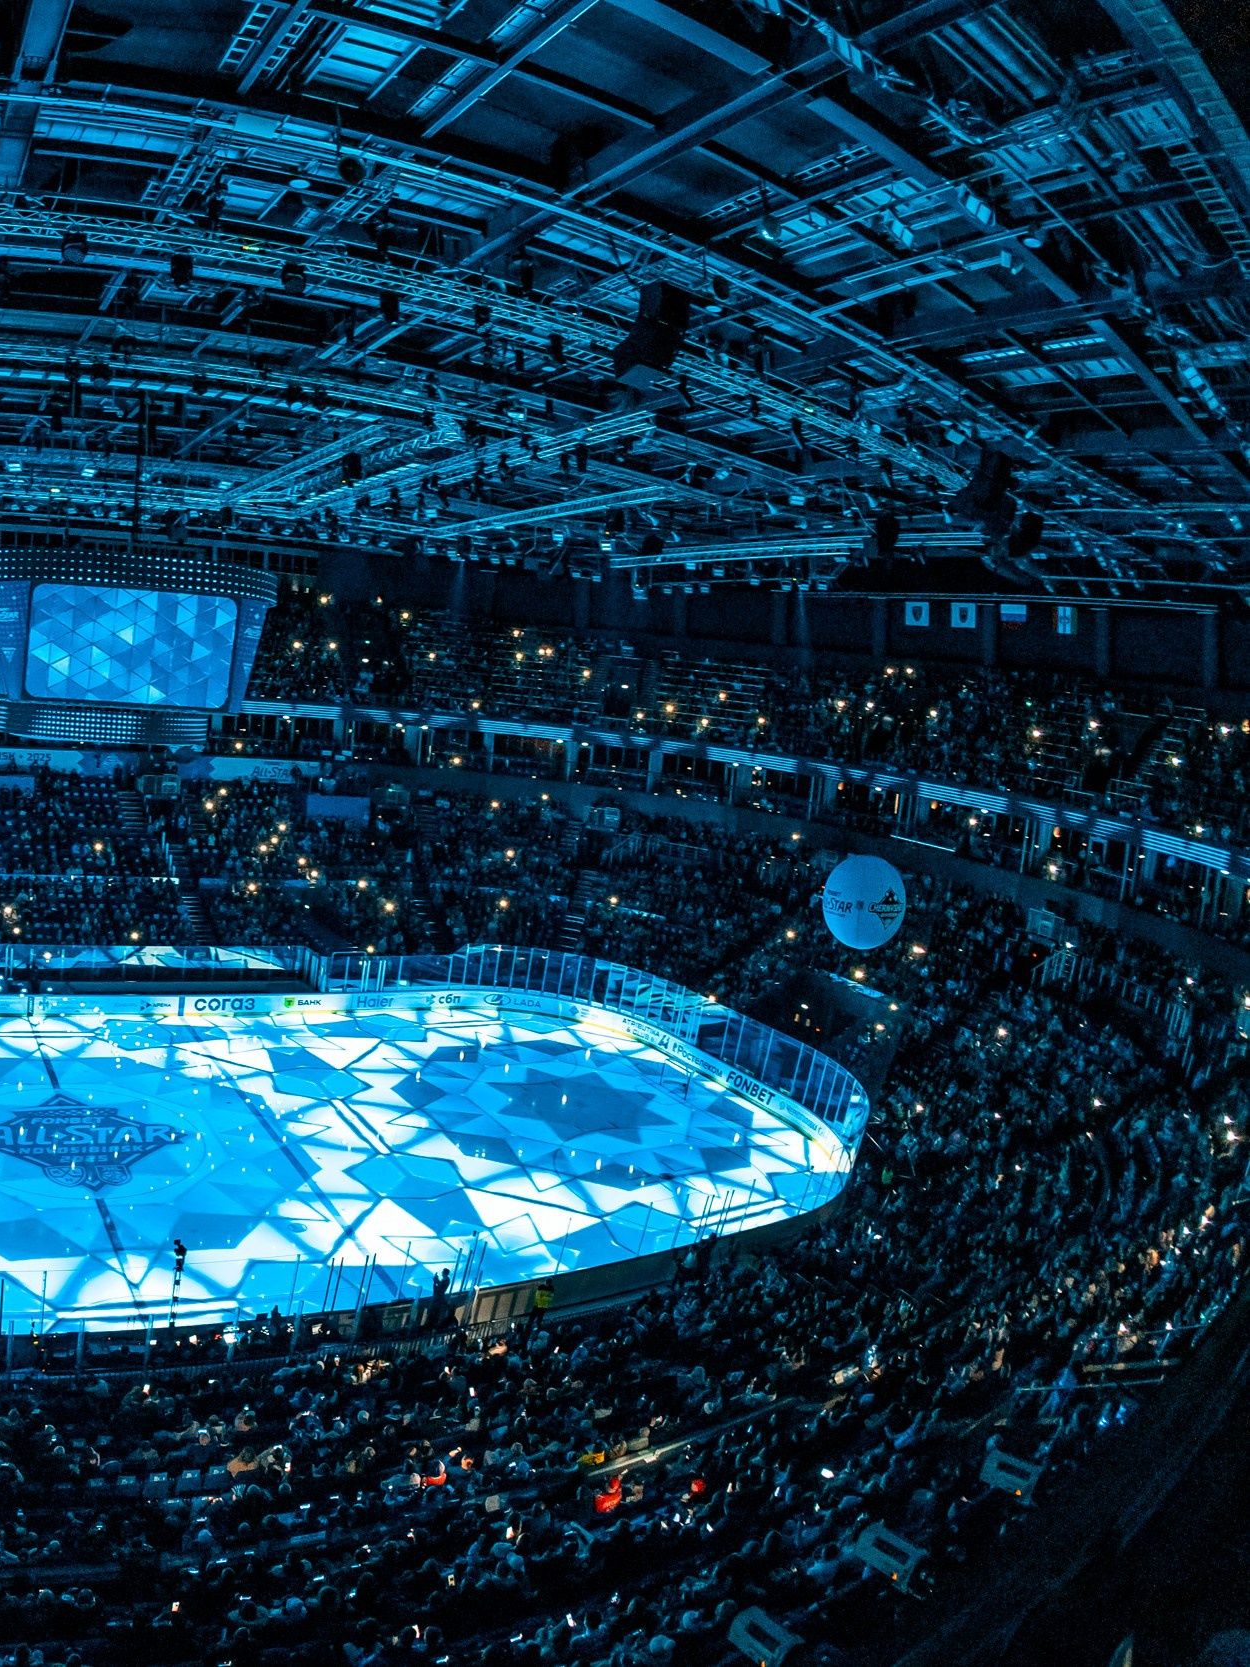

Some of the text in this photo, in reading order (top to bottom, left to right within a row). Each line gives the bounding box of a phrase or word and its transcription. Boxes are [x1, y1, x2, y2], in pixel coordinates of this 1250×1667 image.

[27, 752, 52, 761] 2025
[357, 997, 393, 1008] Haier
[439, 993, 461, 1005] сбп
[514, 998, 541, 1009] LADA
[678, 1044, 723, 1078] Ростелеком
[726, 1070, 775, 1106] FONBET
[31, 1116, 104, 1125] FONBET
[19, 1145, 143, 1154] NOVOSIBIRSK
[59, 1155, 108, 1163] 2025
